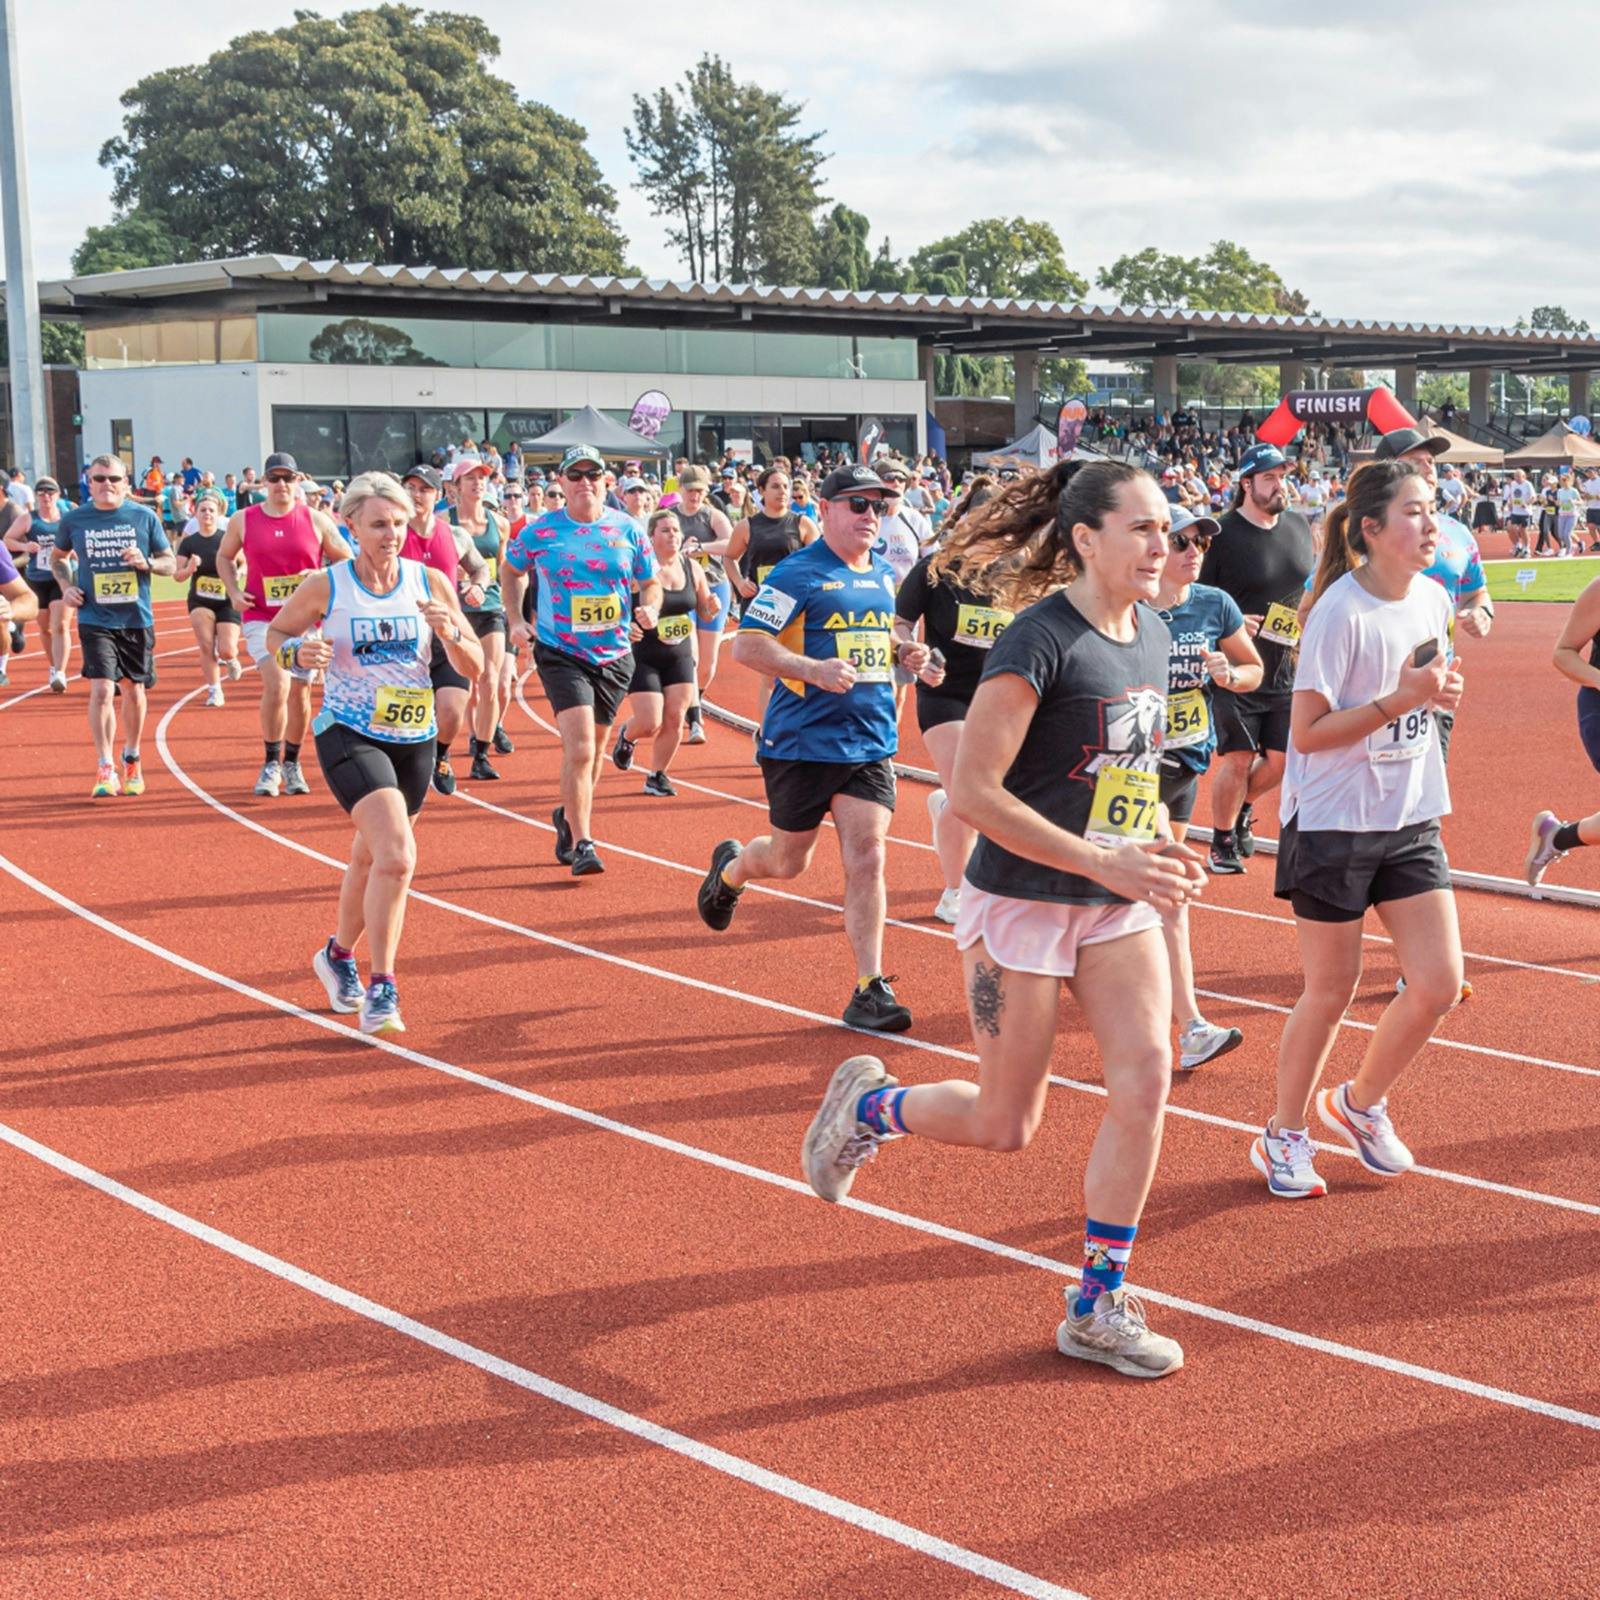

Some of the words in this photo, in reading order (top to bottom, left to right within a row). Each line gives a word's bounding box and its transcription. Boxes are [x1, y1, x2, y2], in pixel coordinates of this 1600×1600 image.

[1295, 396, 1361, 414] FINISH
[85, 528, 136, 539] Maitland
[86, 539, 137, 549] Running
[87, 548, 122, 558] Festiv
[102, 582, 132, 595] 527
[580, 606, 615, 622] 510
[353, 618, 417, 641] RUN
[664, 624, 689, 638] 566
[965, 618, 1006, 638] 516
[1178, 631, 1206, 642] 2025
[1168, 638, 1210, 656] land
[849, 647, 887, 667] 582
[384, 703, 427, 724] 569
[1386, 709, 1429, 742] 195
